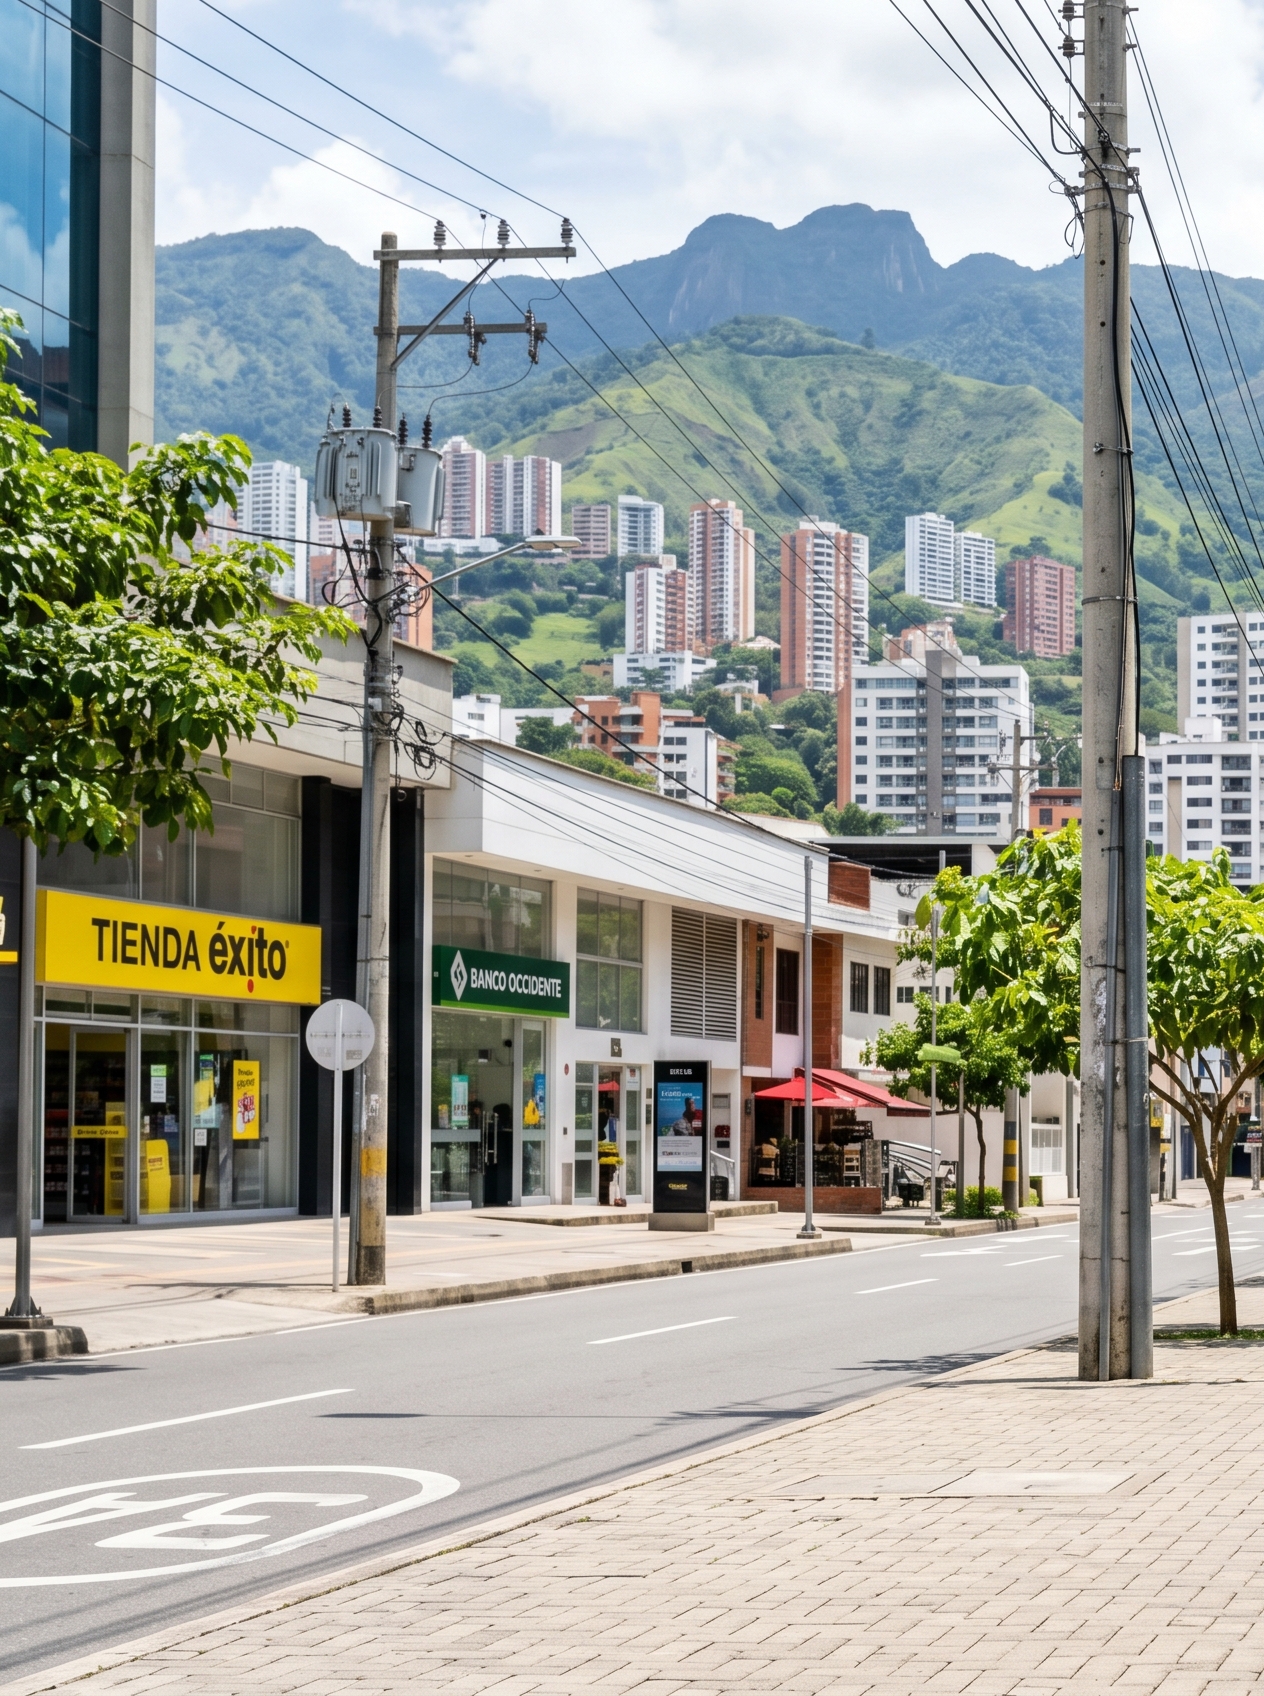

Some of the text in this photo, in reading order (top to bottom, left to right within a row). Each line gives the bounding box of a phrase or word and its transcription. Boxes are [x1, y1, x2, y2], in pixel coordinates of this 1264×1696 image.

[91, 917, 287, 993] TIENDA éxito
[470, 967, 562, 998] BANCO OCCIDENTE
